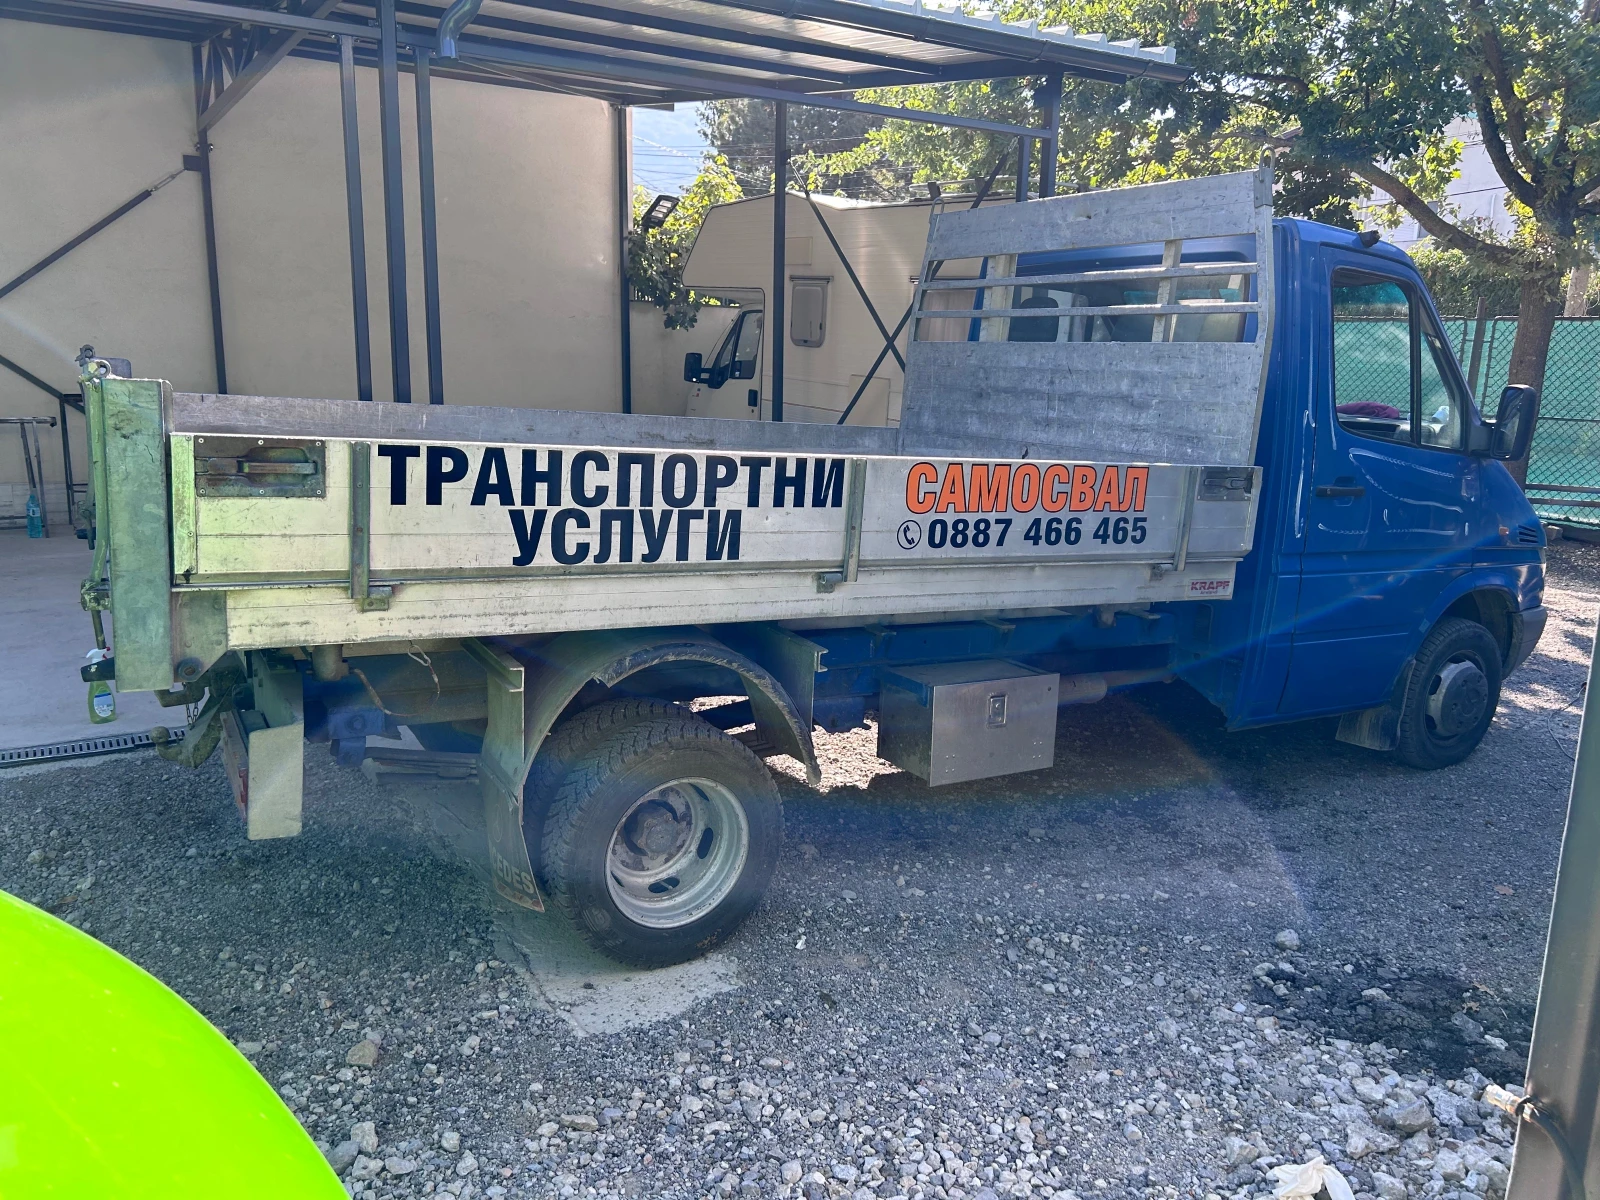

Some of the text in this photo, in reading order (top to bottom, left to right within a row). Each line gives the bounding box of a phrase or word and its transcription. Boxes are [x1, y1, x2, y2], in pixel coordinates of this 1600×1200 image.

[378, 444, 846, 509] ТРАНСПОРТНИ
[905, 462, 1150, 514] САМОСВАЛ
[511, 508, 742, 566] УСЛУГИ
[927, 516, 1148, 549] 0887 466 465
[1190, 580, 1231, 591] KRAPF
